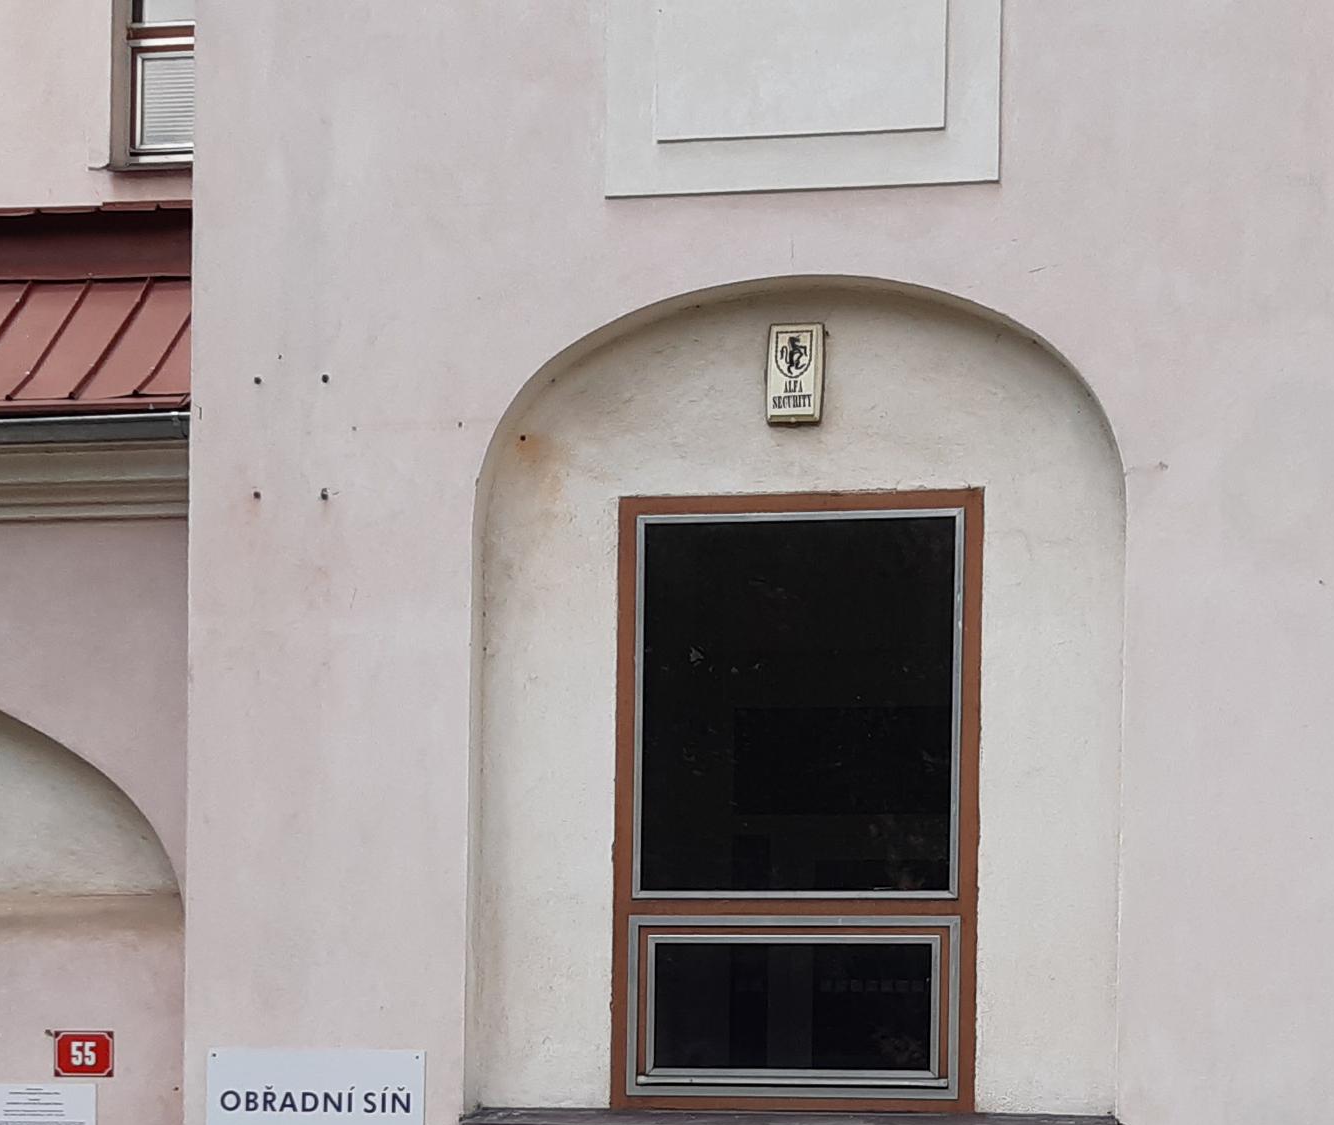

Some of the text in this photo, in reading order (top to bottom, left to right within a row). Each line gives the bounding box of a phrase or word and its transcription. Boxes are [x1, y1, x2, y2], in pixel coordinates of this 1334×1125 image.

[784, 380, 803, 393] ALFA
[772, 394, 812, 409] SECURITY
[70, 1041, 97, 1067] 55
[220, 1085, 412, 1114] OBŘADNÍ SÍŇ
